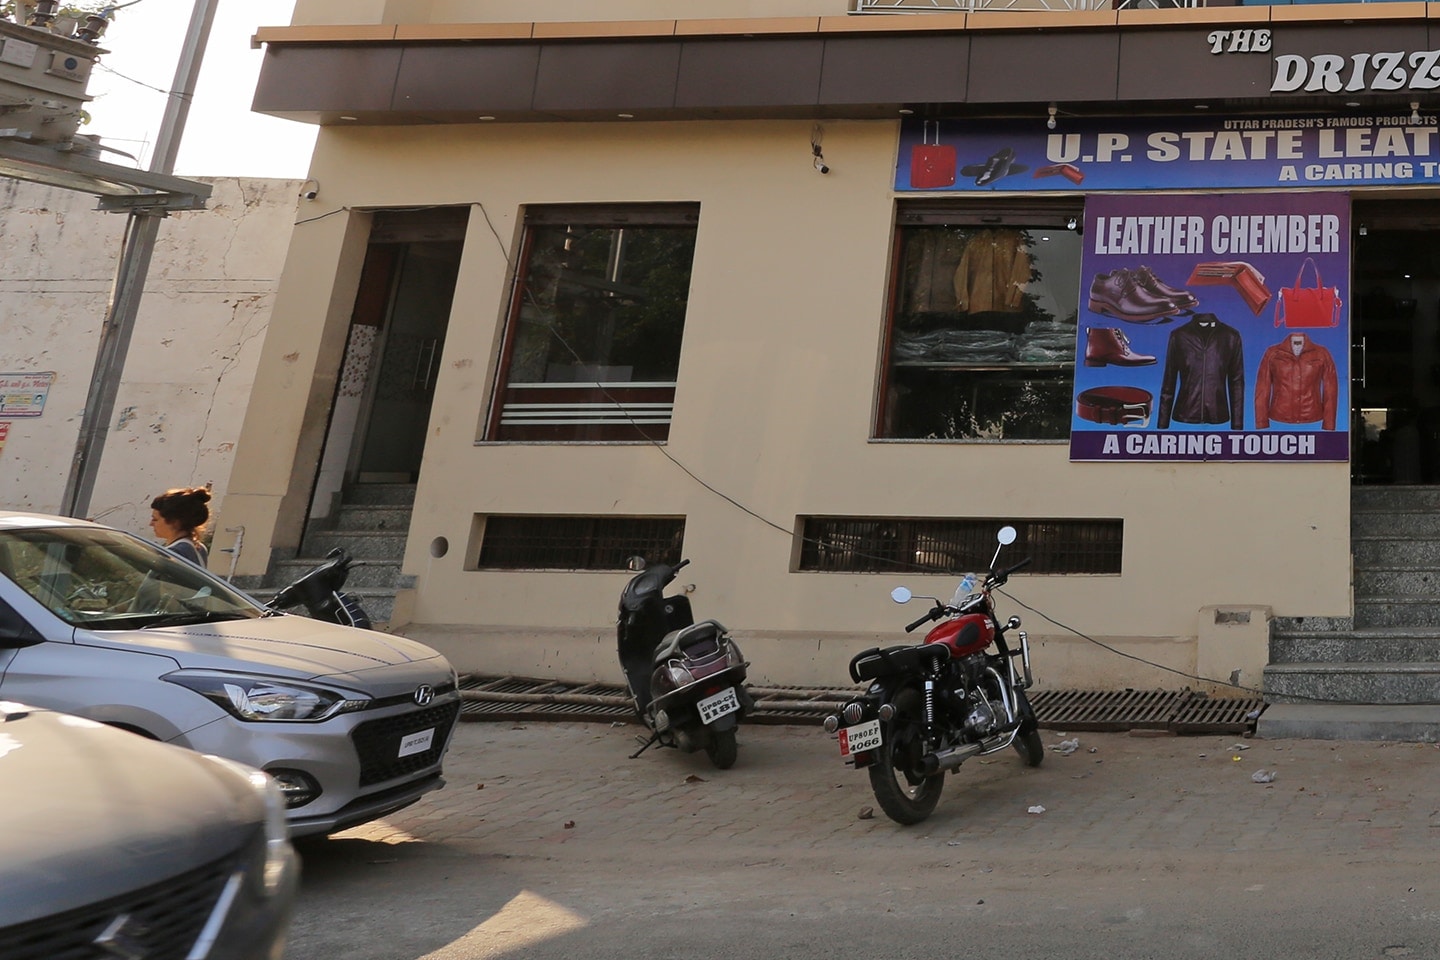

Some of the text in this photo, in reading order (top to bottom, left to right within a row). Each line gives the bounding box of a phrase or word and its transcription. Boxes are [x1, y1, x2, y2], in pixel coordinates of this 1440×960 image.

[1207, 29, 1272, 55] THE
[1223, 120, 1260, 129] UTTAR
[1262, 118, 1324, 128] PRADESH'S
[1326, 117, 1374, 127] FAMOUS
[1375, 115, 1437, 127] PRODUCTS
[1046, 133, 1132, 163] U.P.
[1146, 130, 1304, 162] STATE
[1278, 165, 1298, 181] A
[1305, 162, 1413, 181] CARING
[1095, 214, 1340, 255] LEATHER CHEMBER
[1102, 433, 1316, 455] A CARING TOUCH
[850, 737, 879, 752] 4066
